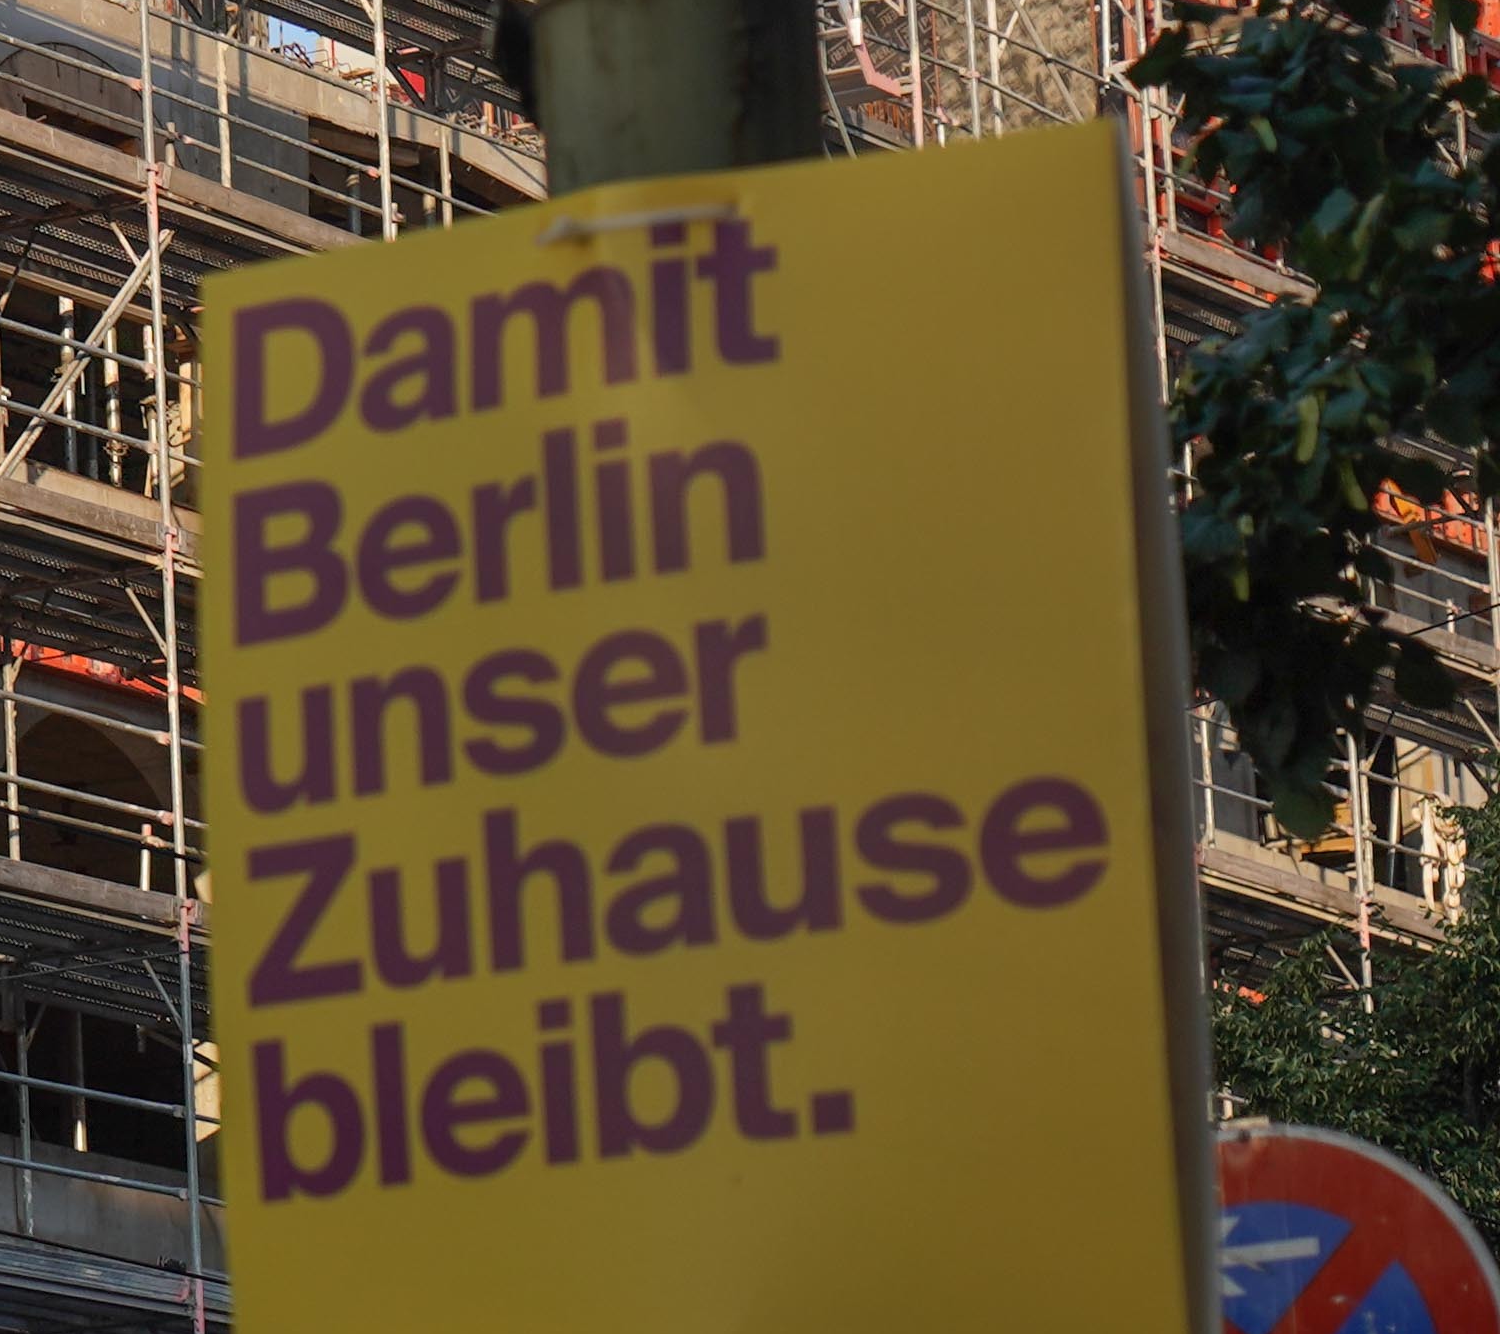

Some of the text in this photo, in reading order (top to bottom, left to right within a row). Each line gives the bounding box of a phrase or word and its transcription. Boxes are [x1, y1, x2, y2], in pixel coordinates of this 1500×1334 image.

[232, 208, 778, 460] Damit
[232, 420, 766, 647] Berlin
[238, 615, 768, 815] unser
[247, 777, 1108, 1007] Zuhause
[253, 983, 855, 1202] bleibt.
